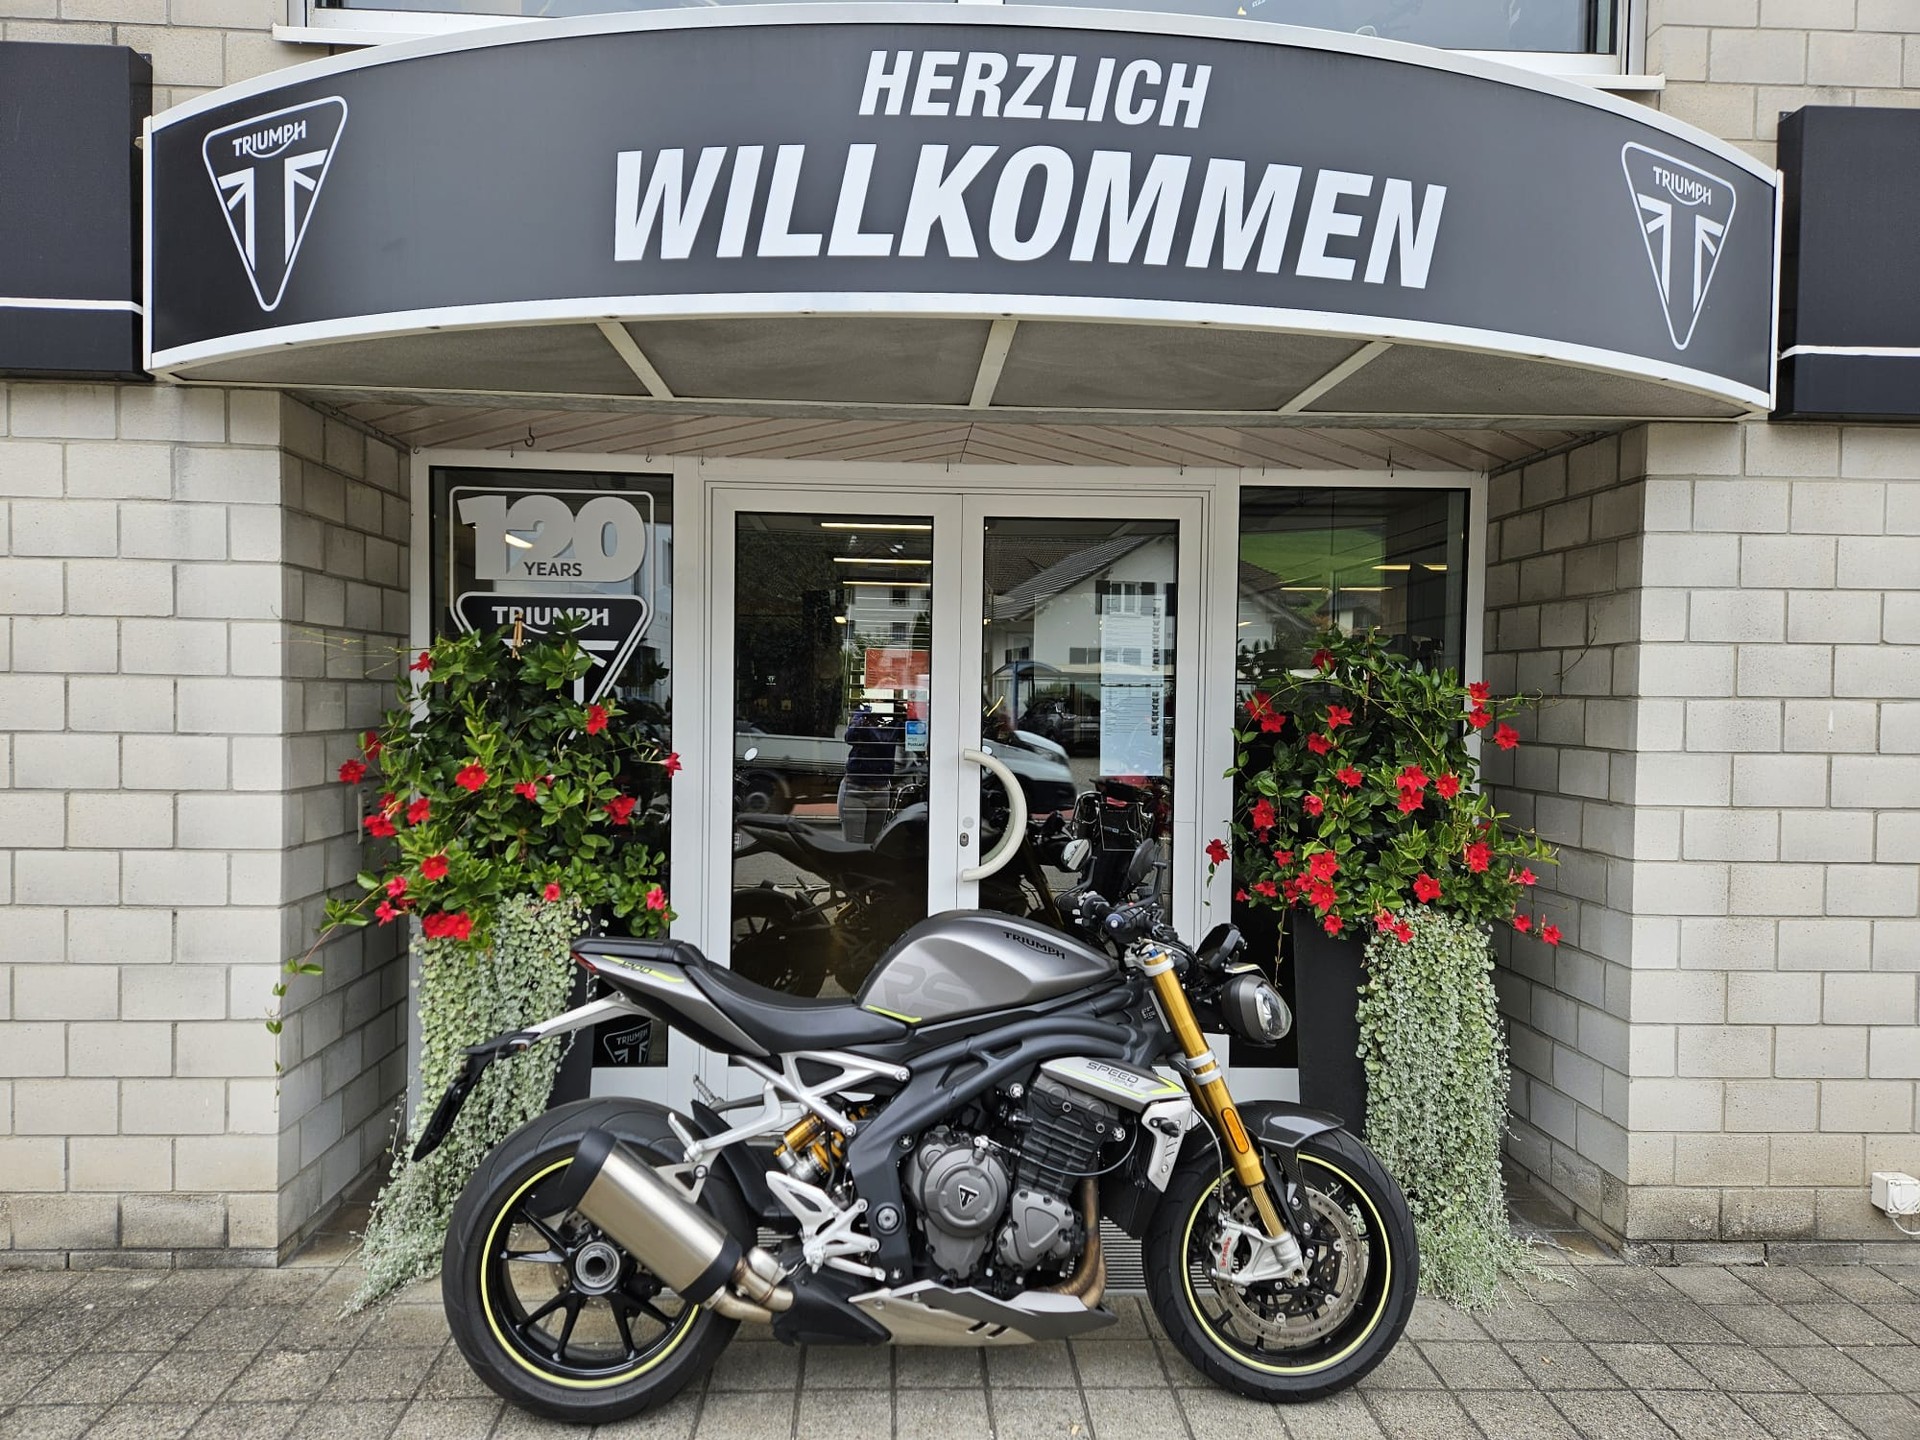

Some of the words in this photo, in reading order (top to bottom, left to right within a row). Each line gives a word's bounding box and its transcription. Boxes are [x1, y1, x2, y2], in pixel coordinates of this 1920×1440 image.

[859, 50, 1213, 129] HERZLICH
[232, 120, 306, 158] TRIUMPH
[1653, 166, 1711, 206] TRIUMPH
[614, 143, 1447, 289] WILLKOMMEN
[457, 494, 647, 583] 120
[523, 561, 583, 577] YEARS
[1003, 931, 1066, 960] TRIUMPH
[883, 961, 970, 1014] RS
[616, 1028, 648, 1045] TRIUMPH
[1086, 1062, 1139, 1083] SPEED
